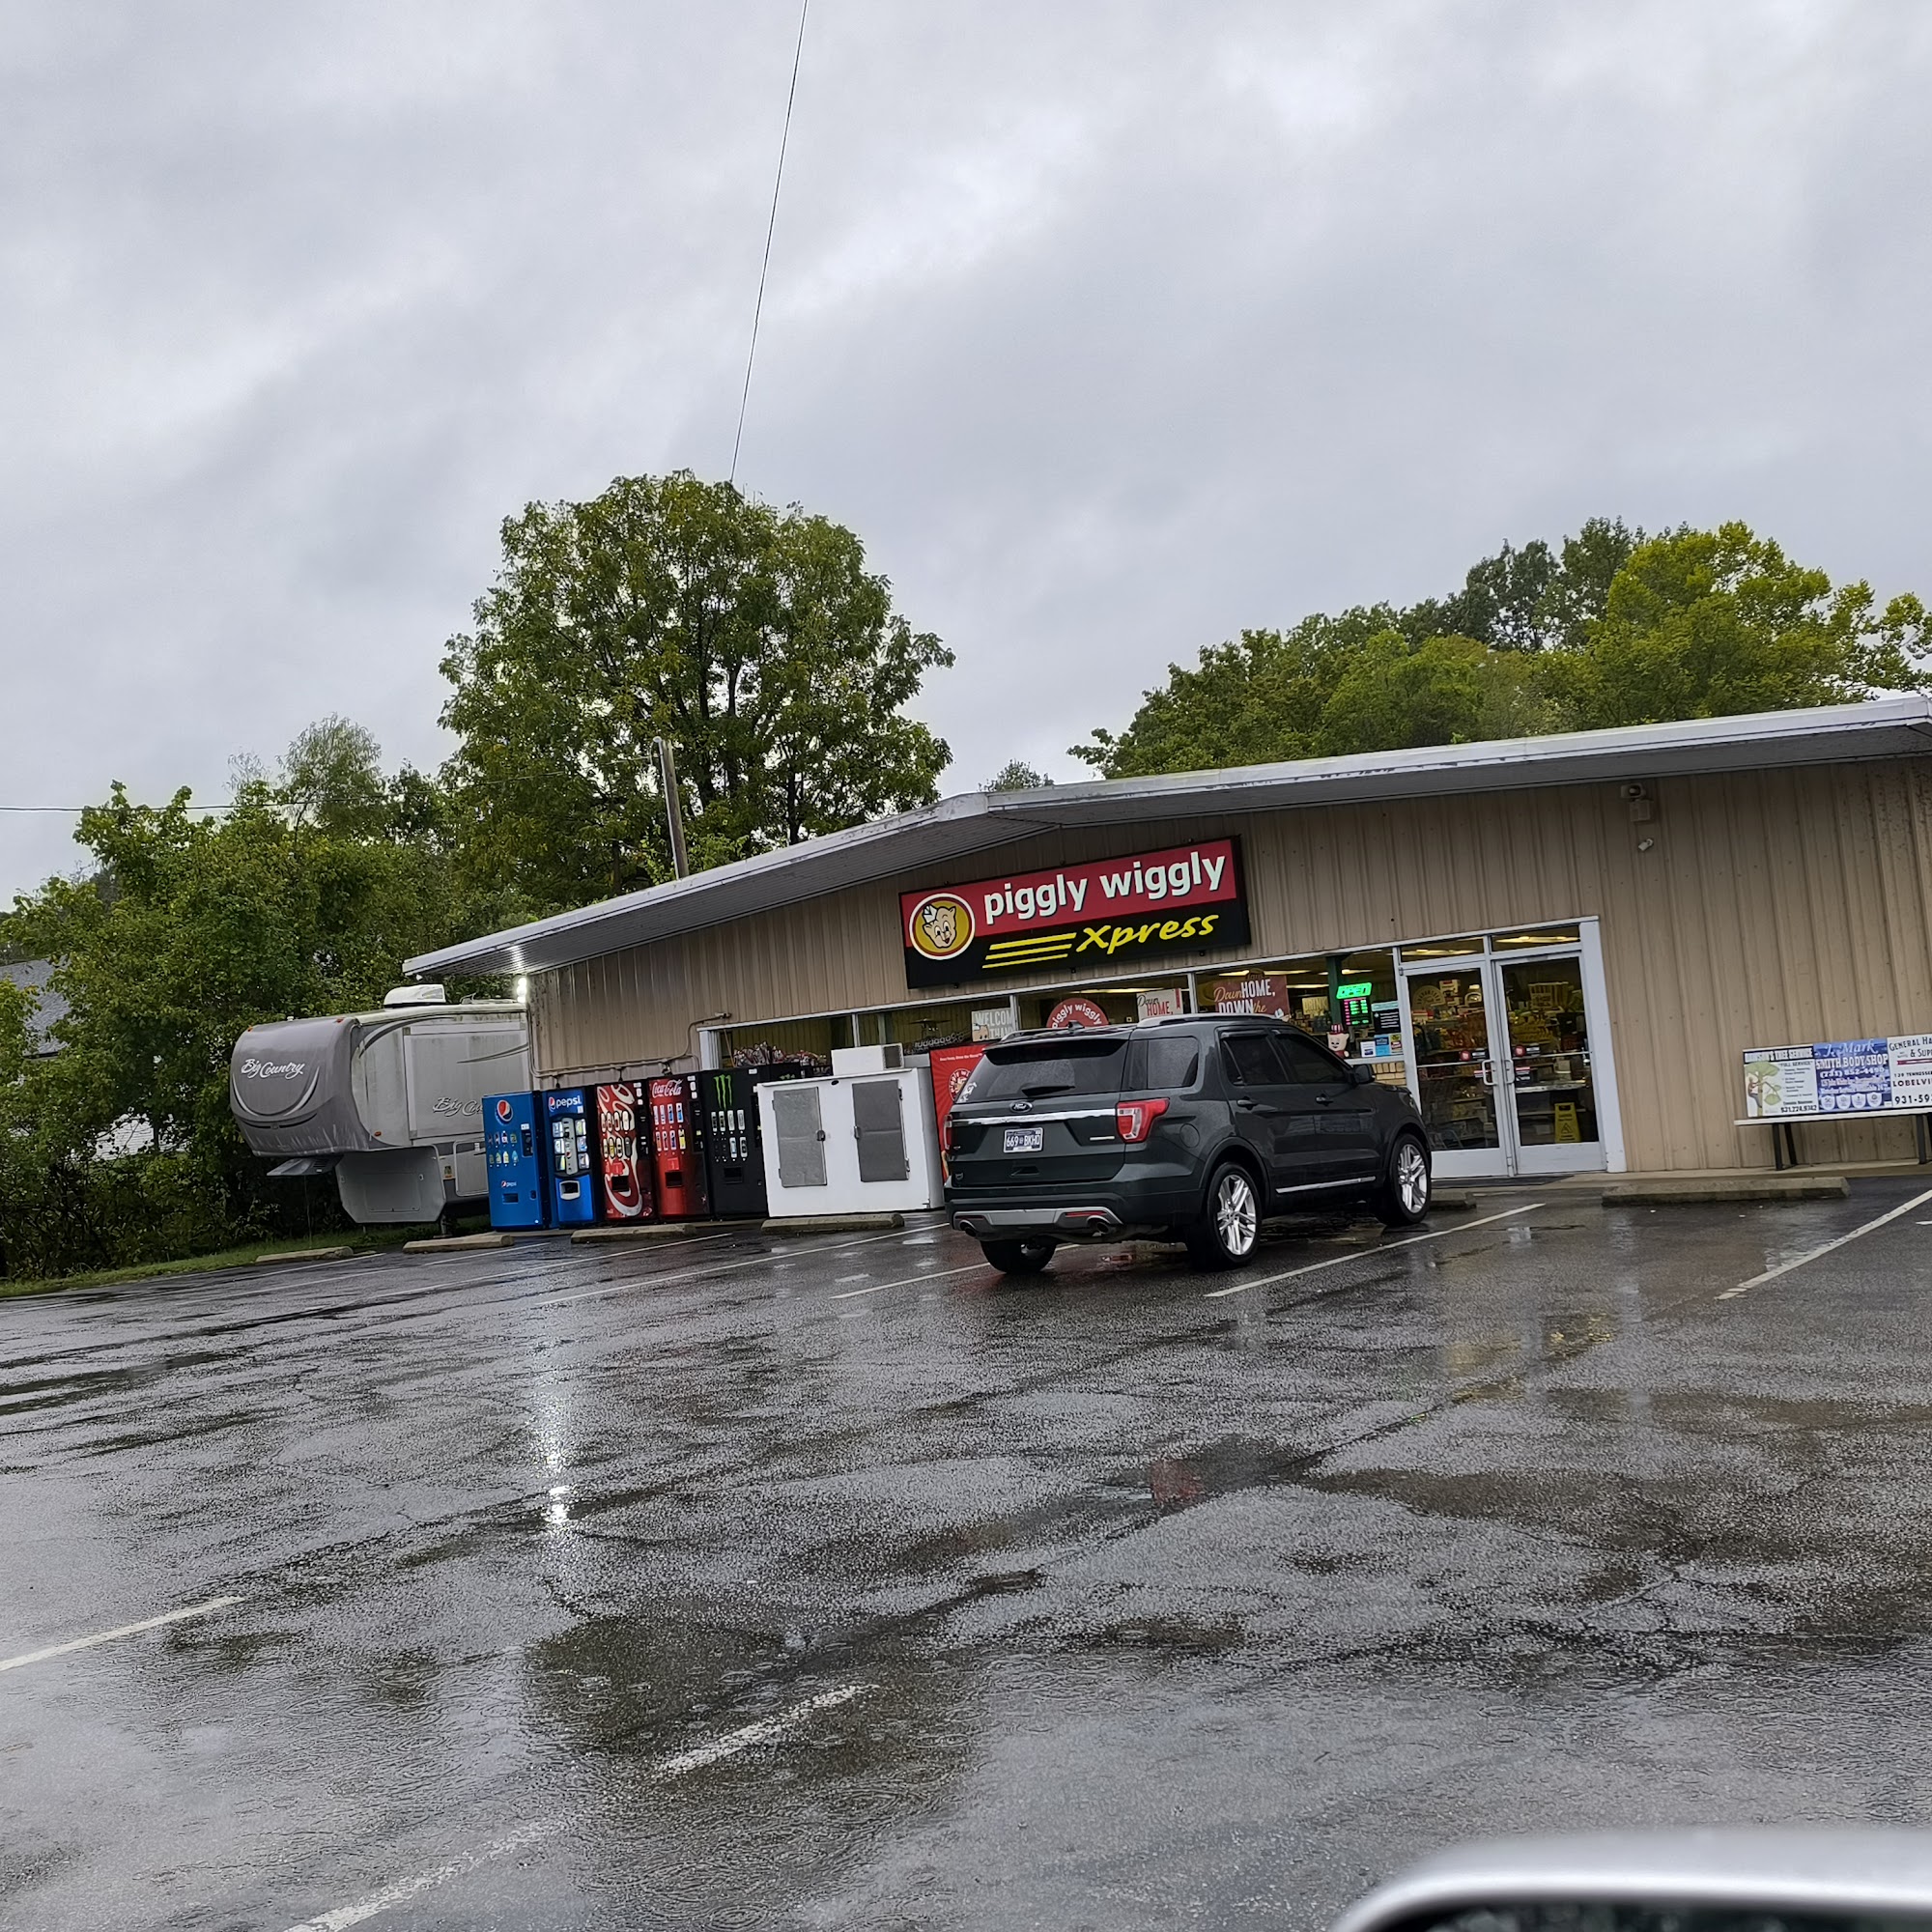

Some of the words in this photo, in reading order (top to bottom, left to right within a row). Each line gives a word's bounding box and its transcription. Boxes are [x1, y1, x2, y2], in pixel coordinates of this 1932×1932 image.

[983, 873, 1088, 924] piggly
[1099, 851, 1225, 899] wiggly
[1076, 914, 1219, 954] Xpress
[1214, 986, 1242, 1002] Down
[1240, 979, 1276, 998] HOME,
[1147, 1001, 1174, 1016] HOME,
[1218, 999, 1254, 1013] DOWN
[1051, 1005, 1073, 1029] piggly
[1074, 1003, 1102, 1025] wiggly
[1889, 1038, 1920, 1051] GENERAL
[1842, 1055, 1865, 1067] BODY
[1865, 1054, 1889, 1065] SHOP
[1910, 1049, 1916, 1058] &
[241, 1059, 262, 1079] Big
[259, 1062, 305, 1080] Country
[433, 1097, 463, 1117] Big
[555, 1094, 582, 1109] pepsi
[1006, 1135, 1019, 1148] 669
